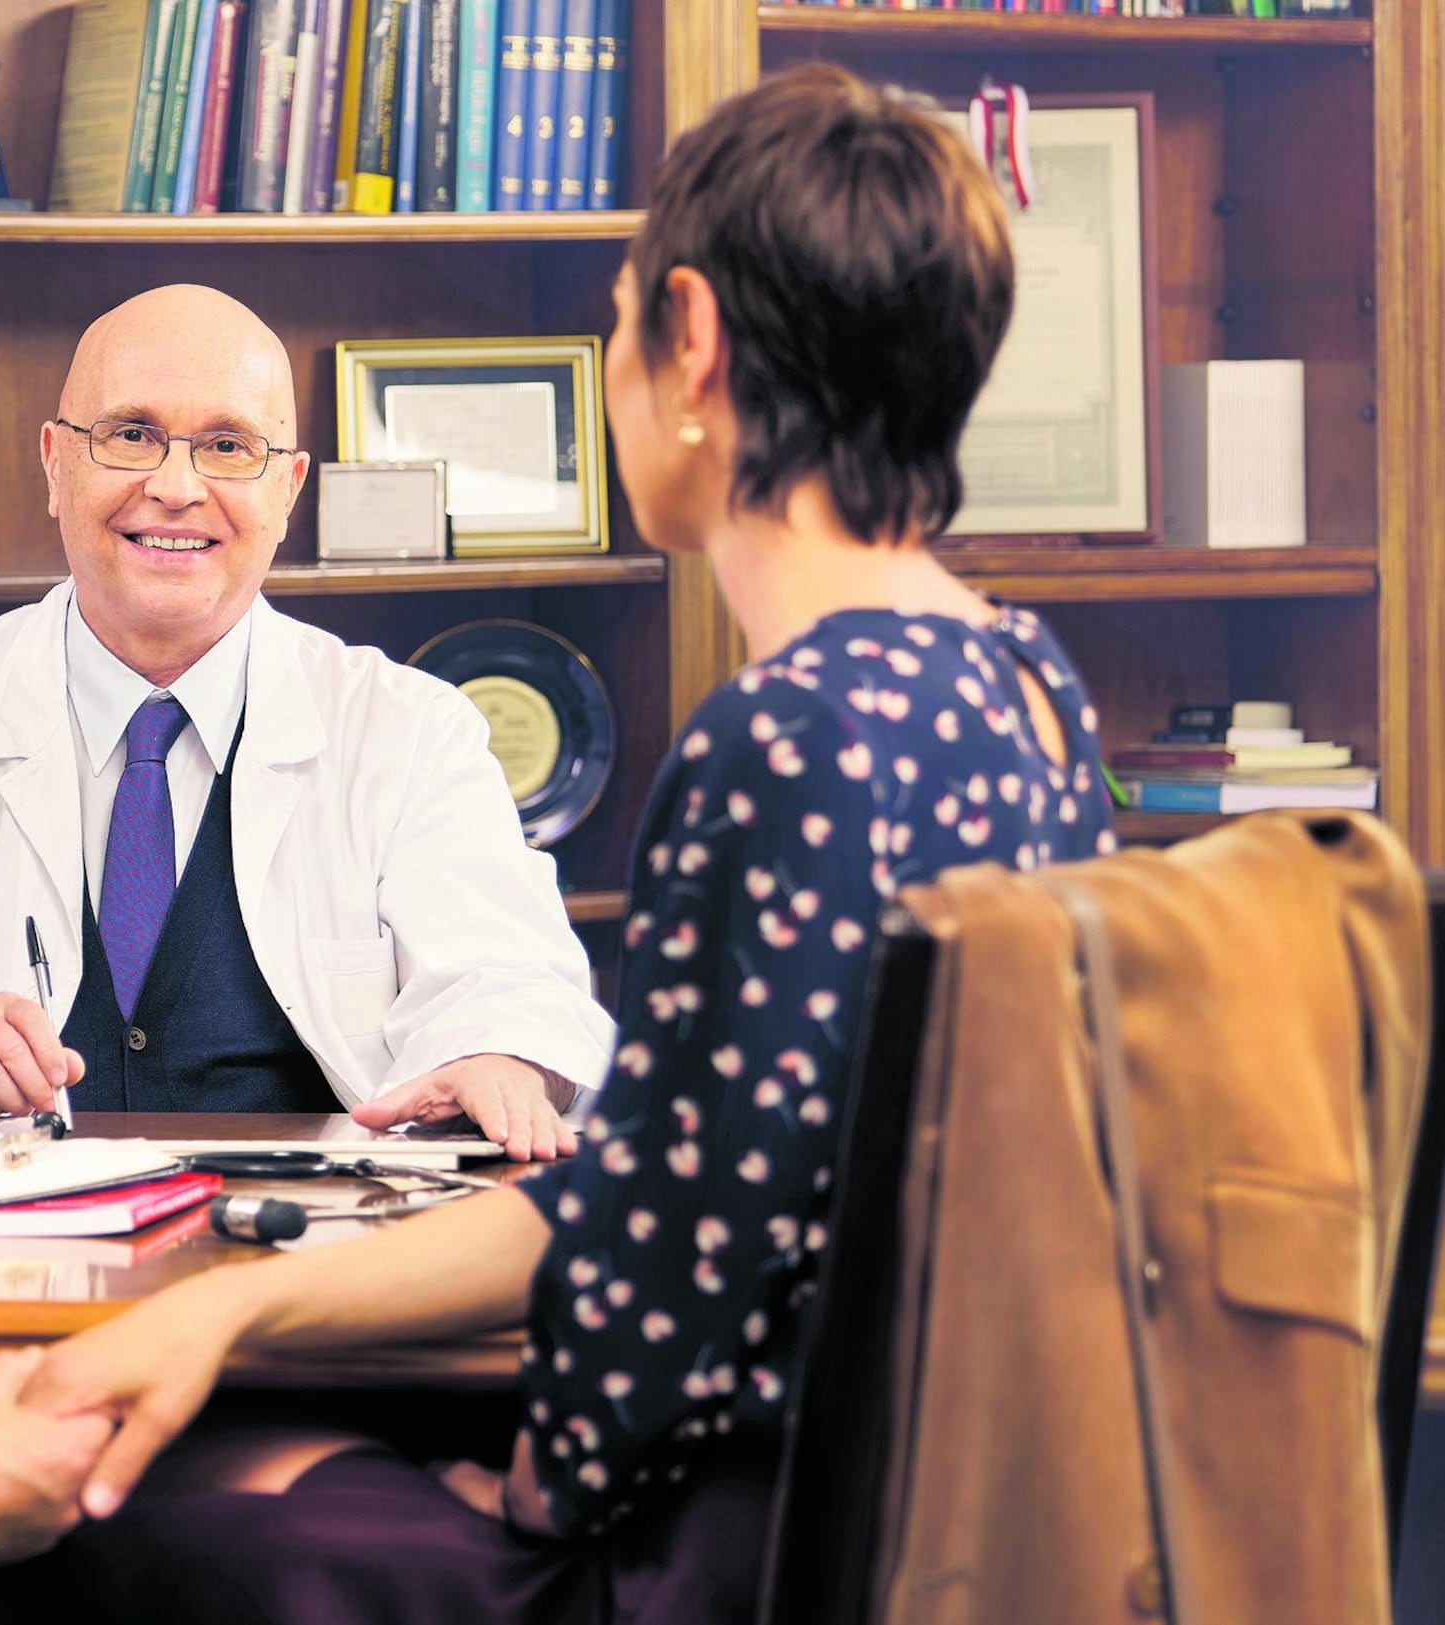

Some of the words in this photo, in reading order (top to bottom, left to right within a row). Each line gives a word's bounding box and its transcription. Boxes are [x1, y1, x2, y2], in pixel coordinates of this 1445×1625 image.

[507, 115, 523, 138] 4
[538, 115, 554, 140] 3
[568, 115, 585, 139] 2
